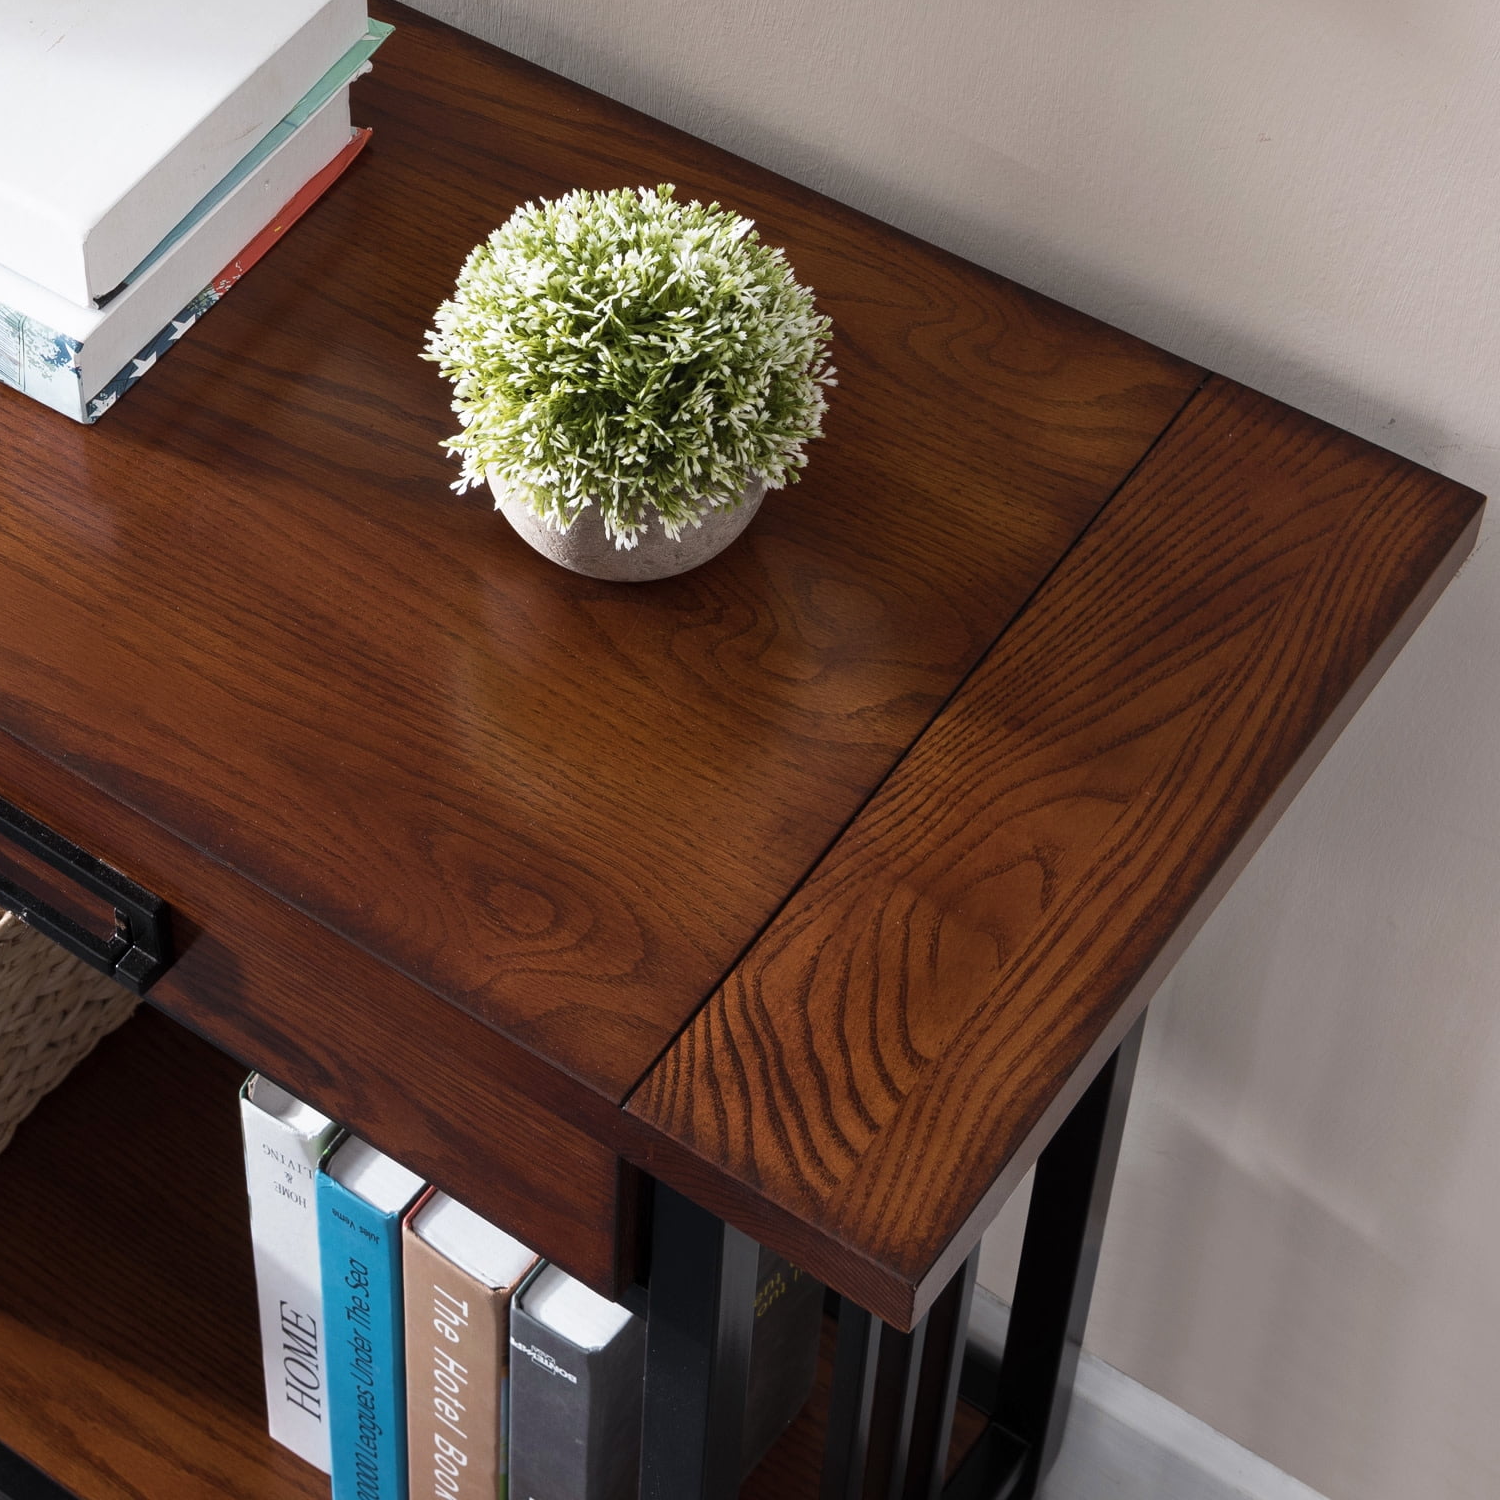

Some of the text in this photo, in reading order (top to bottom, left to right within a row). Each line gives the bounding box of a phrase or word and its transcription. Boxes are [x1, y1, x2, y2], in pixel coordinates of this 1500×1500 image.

[262, 1143, 313, 1180] LIVING
[284, 1171, 293, 1184] &
[273, 1180, 307, 1209] HOME
[359, 1226, 380, 1245] Jules
[345, 1258, 370, 1297] Sea
[345, 1294, 371, 1331] The
[433, 1284, 469, 1344] The
[279, 1300, 322, 1423] HOME
[347, 1328, 374, 1386] Under
[433, 1346, 469, 1439] Hotel
[354, 1384, 384, 1460] Leagues
